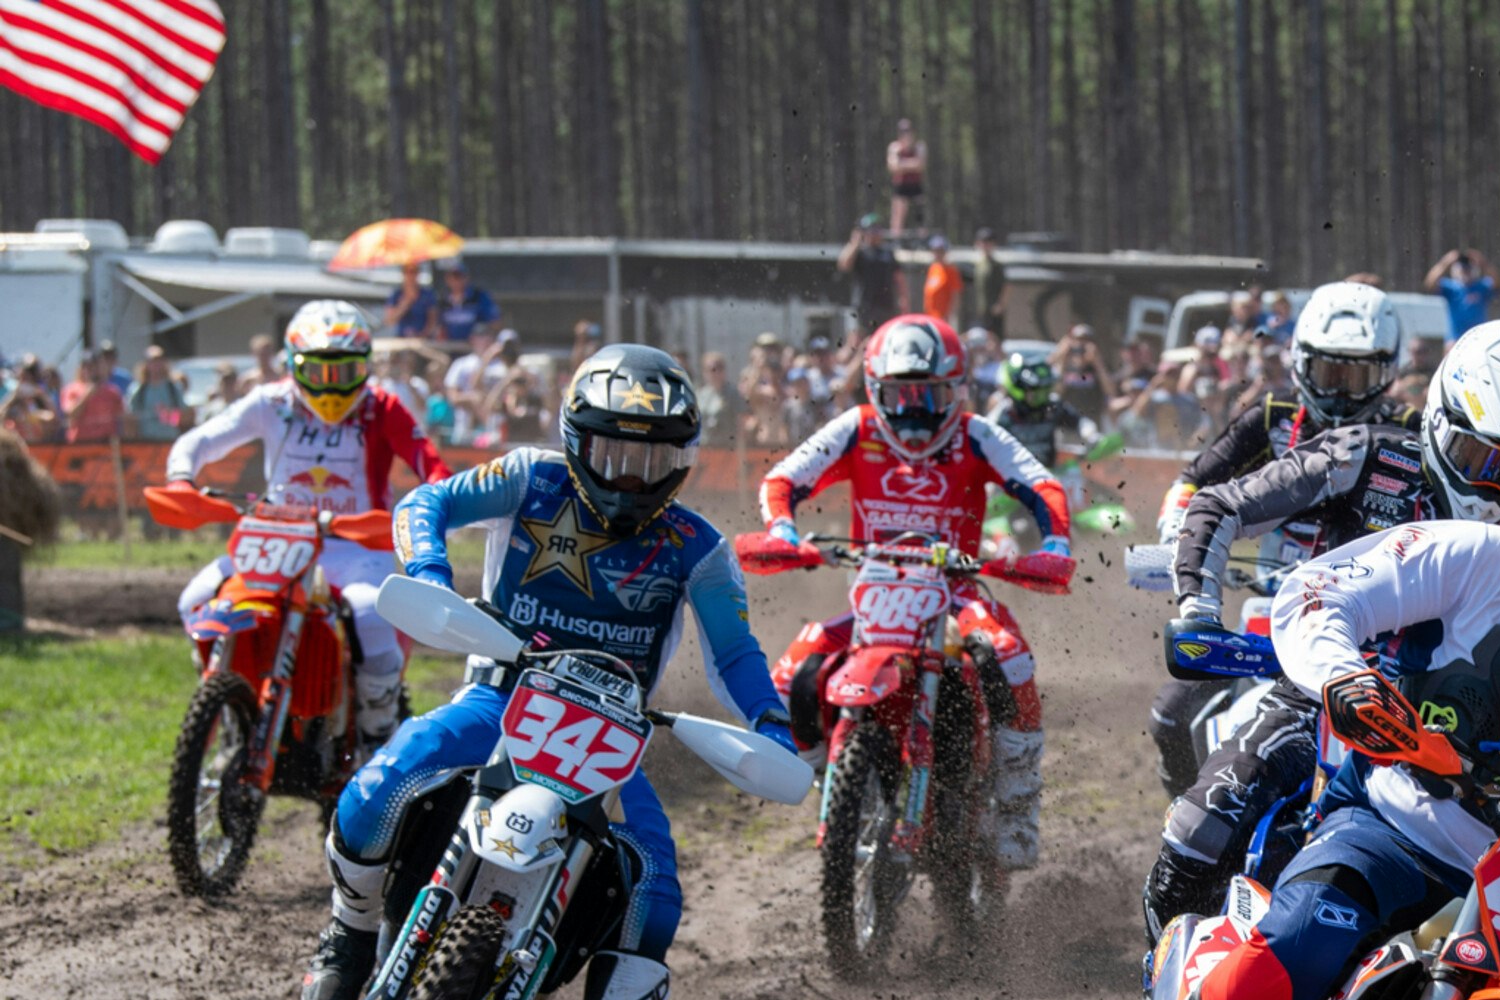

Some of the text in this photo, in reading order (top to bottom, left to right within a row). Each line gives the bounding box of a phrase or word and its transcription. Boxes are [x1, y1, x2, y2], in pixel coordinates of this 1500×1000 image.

[234, 536, 314, 577] 530
[594, 555, 627, 567] FLY
[860, 586, 942, 631] 989
[505, 693, 641, 793] 342
[1361, 709, 1419, 752] ACERBIS
[532, 771, 579, 799] MOTOREX
